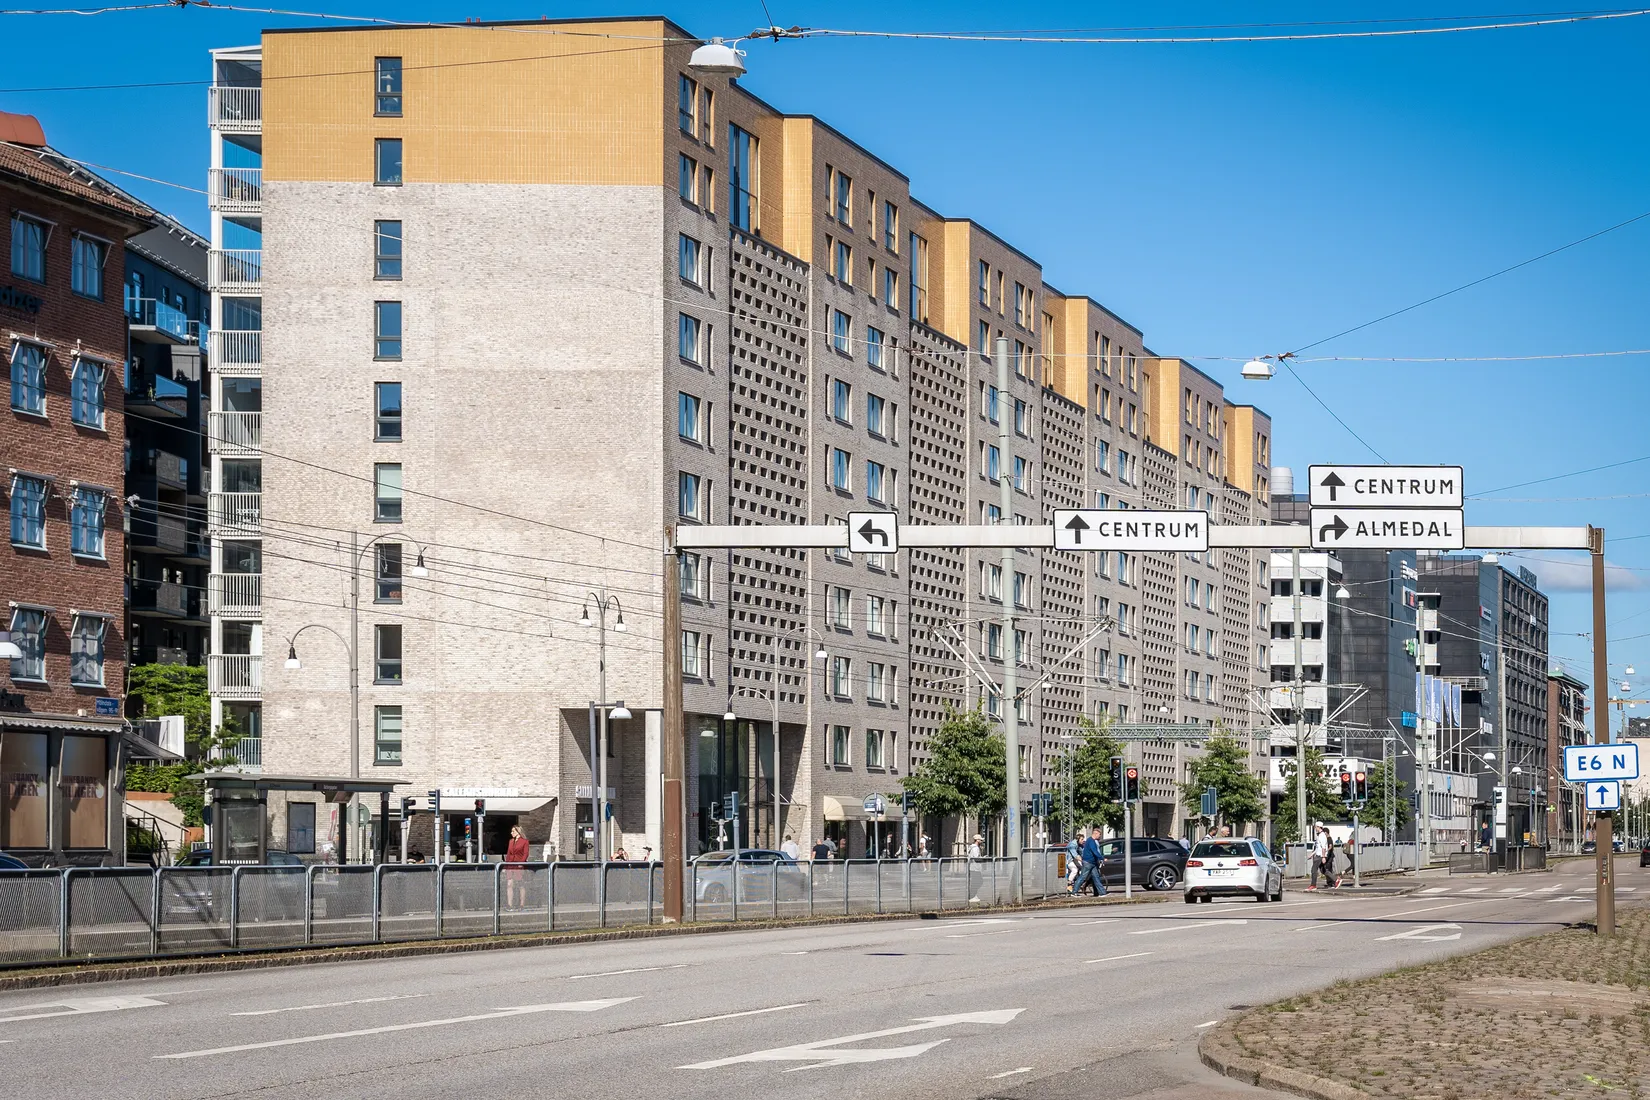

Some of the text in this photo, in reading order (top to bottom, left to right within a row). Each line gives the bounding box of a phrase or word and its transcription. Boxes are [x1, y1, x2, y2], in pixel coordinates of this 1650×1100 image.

[1354, 478, 1453, 494] CENTRUM
[1099, 522, 1198, 538] CENTRUM
[1355, 521, 1452, 537] ALMEDAL
[1578, 754, 1625, 771] E6 N
